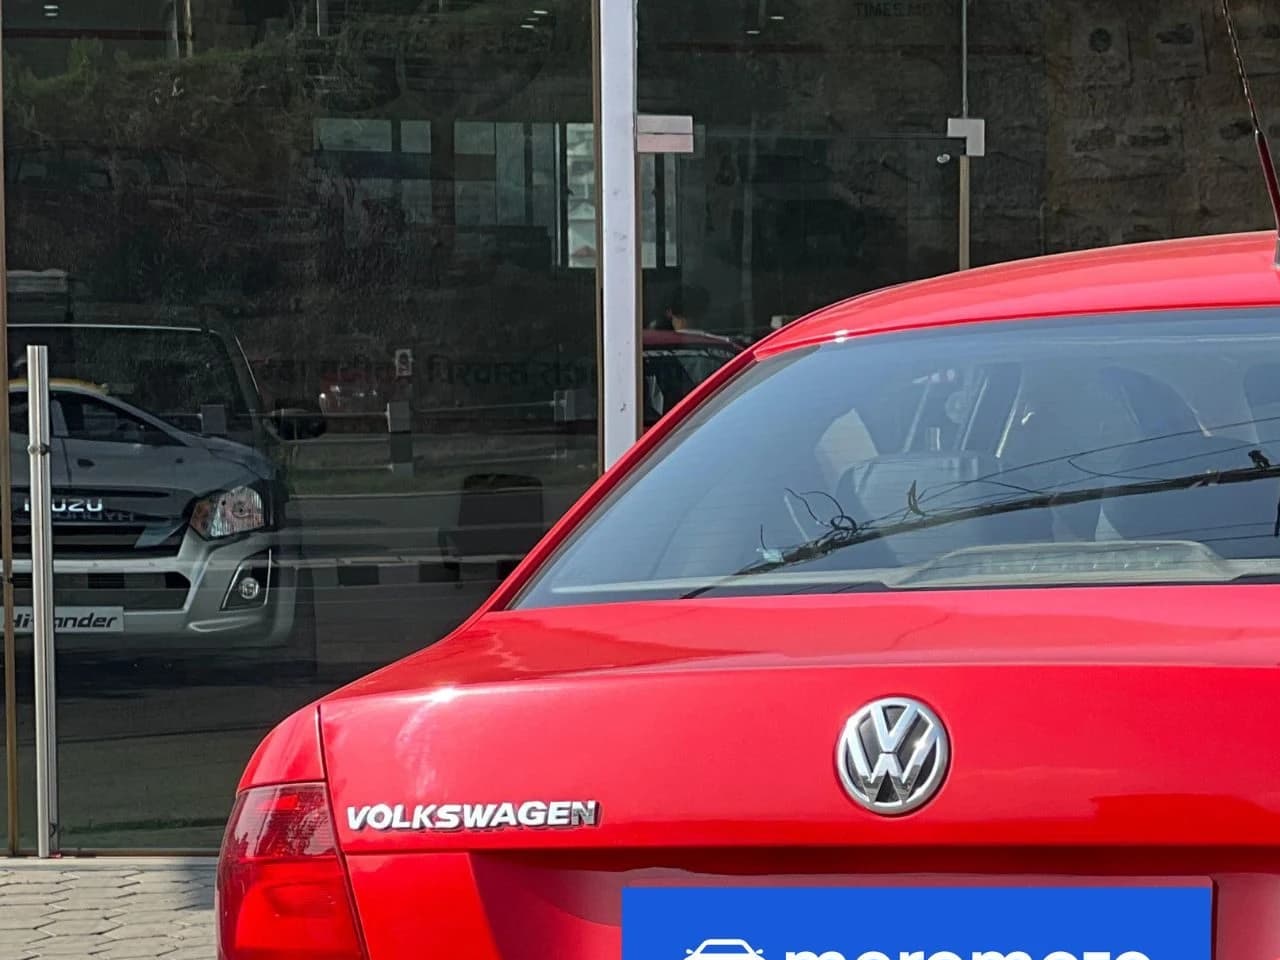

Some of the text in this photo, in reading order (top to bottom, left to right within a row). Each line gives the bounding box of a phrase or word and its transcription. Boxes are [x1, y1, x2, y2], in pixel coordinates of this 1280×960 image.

[24, 498, 103, 512] IUZU
[10, 612, 118, 628] Hiander
[837, 697, 947, 813] VW
[346, 800, 599, 831] VOLKSWAGEN
